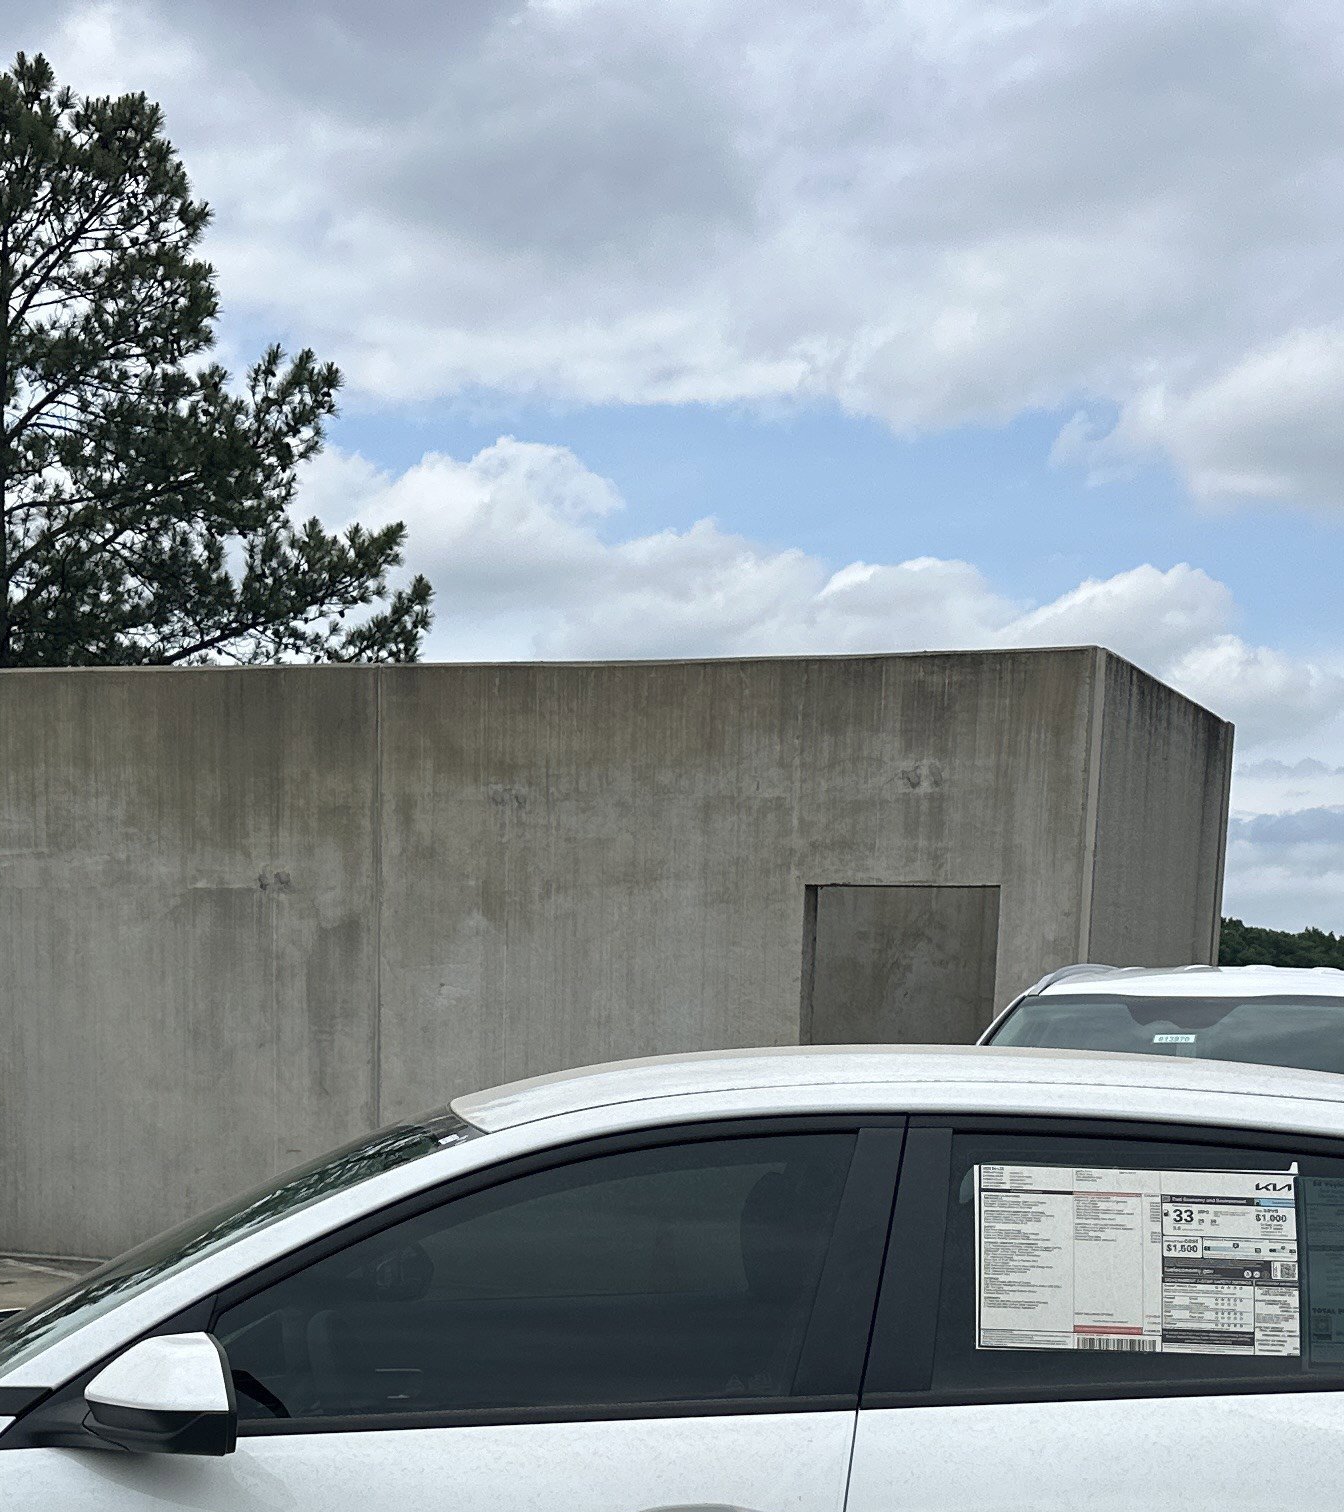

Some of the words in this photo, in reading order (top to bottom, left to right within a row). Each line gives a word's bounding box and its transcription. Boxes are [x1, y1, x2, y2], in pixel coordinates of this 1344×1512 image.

[1255, 1182, 1292, 1192] KIA
[1172, 1209, 1195, 1223] 33
[1255, 1213, 1287, 1223] $1,000
